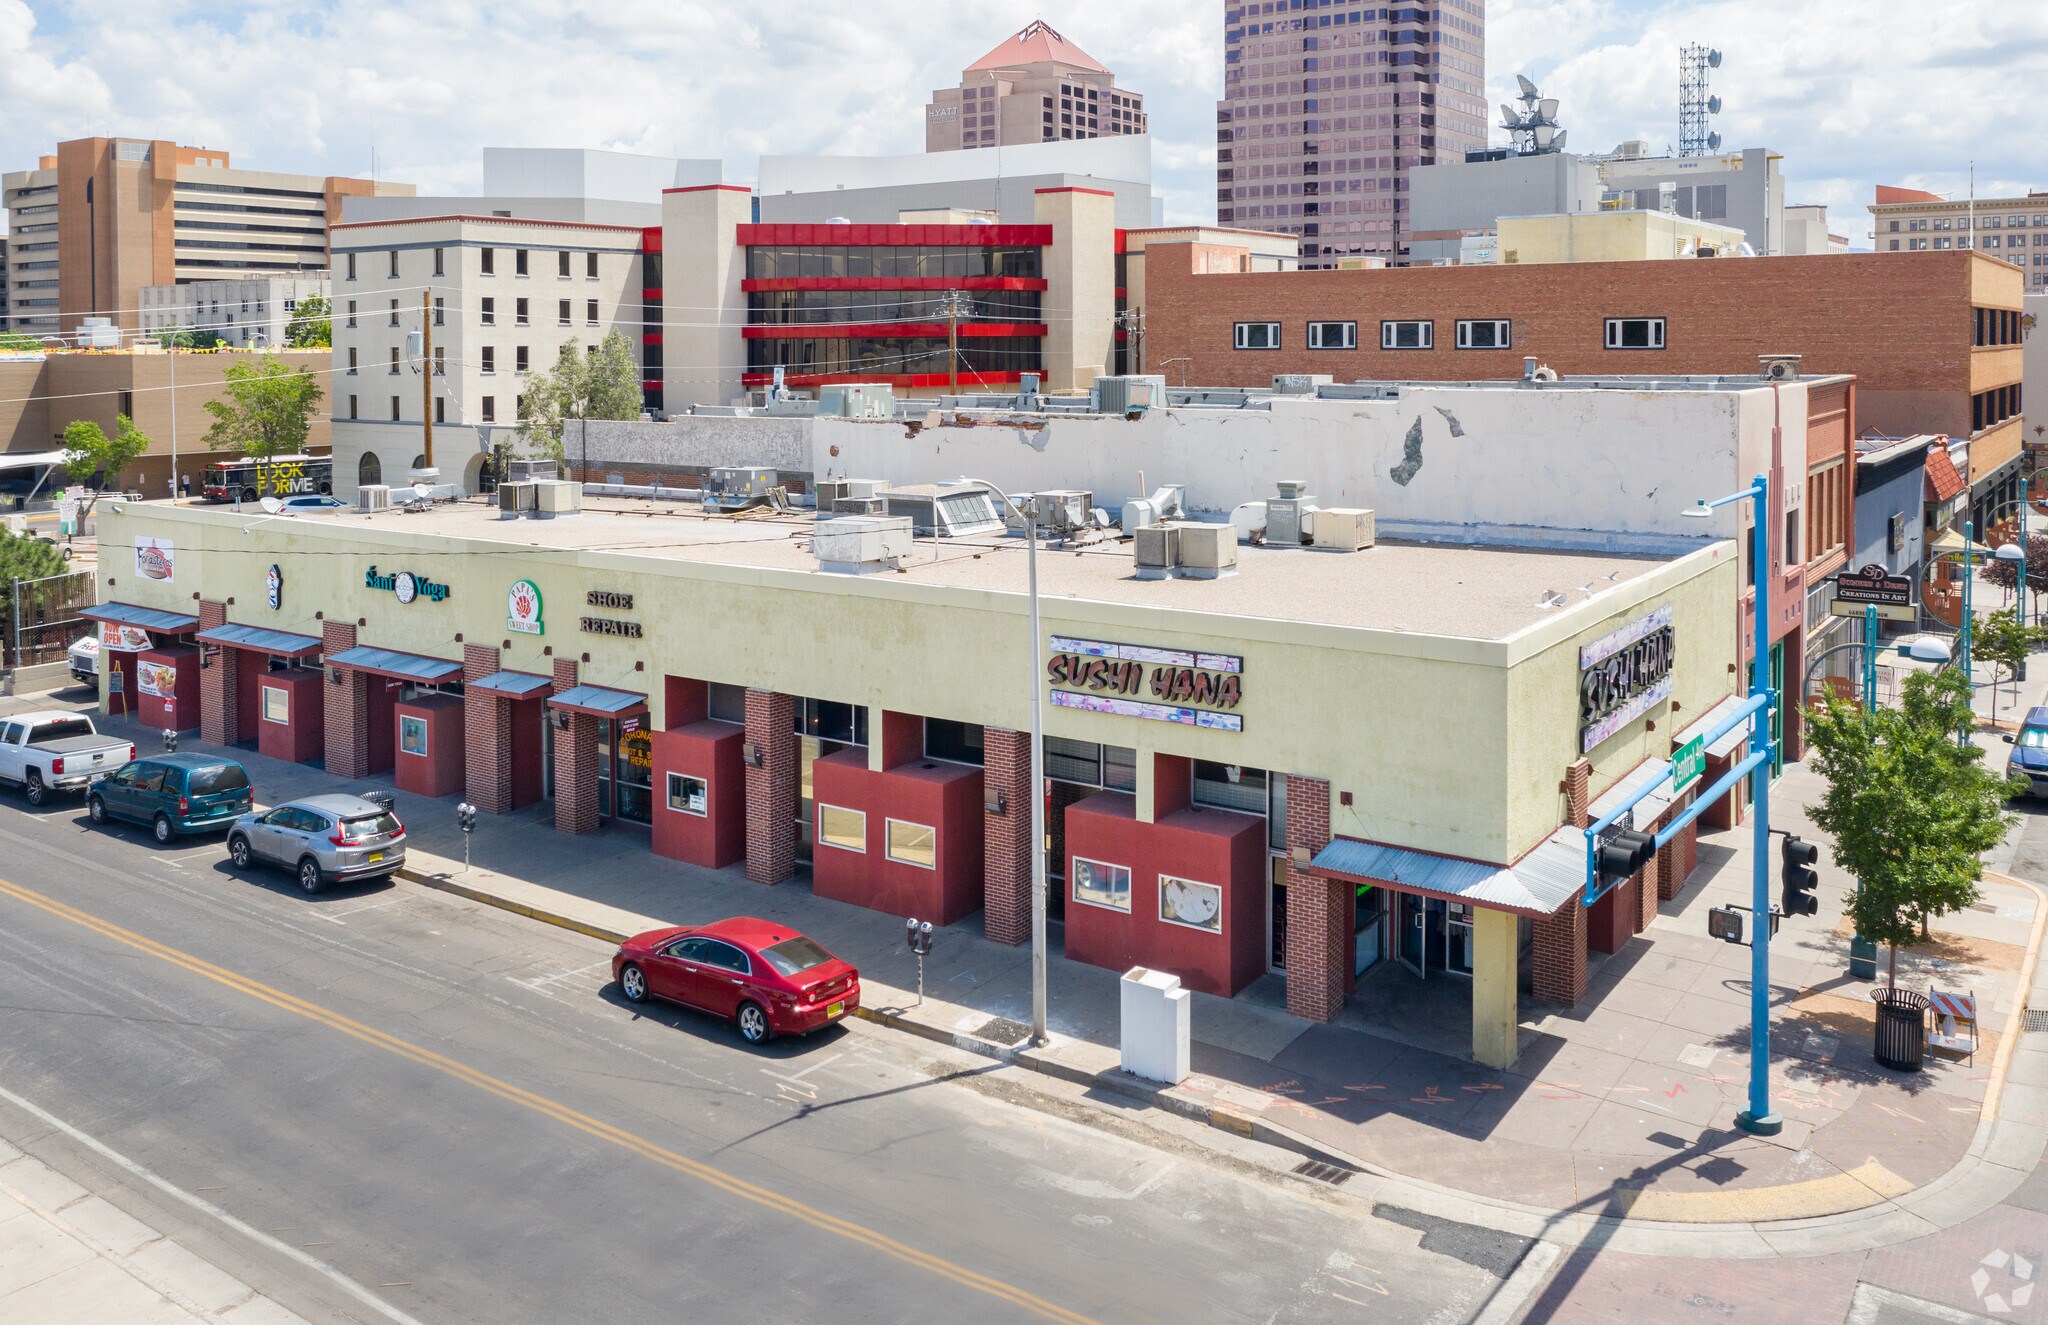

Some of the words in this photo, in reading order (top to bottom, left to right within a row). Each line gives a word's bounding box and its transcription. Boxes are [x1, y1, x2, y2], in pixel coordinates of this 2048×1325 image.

[928, 106, 958, 118] HYATT
[257, 462, 305, 480] LOOK
[137, 546, 173, 569] Forasteros
[415, 576, 449, 602] Yoga
[511, 582, 536, 602] PAPA'S
[587, 590, 633, 610] SHOE
[104, 622, 120, 633] NOW
[508, 620, 525, 631] SWEET
[525, 622, 539, 633] SHOP
[580, 616, 643, 638] REPAIR
[103, 632, 121, 646] OPEN
[1047, 653, 1143, 695] SUSHI
[1149, 666, 1243, 710] HANA
[1580, 649, 1635, 723] SUSHI
[1634, 625, 1675, 686] HANA
[620, 729, 652, 746] CORONA
[1672, 745, 1696, 787] Central
